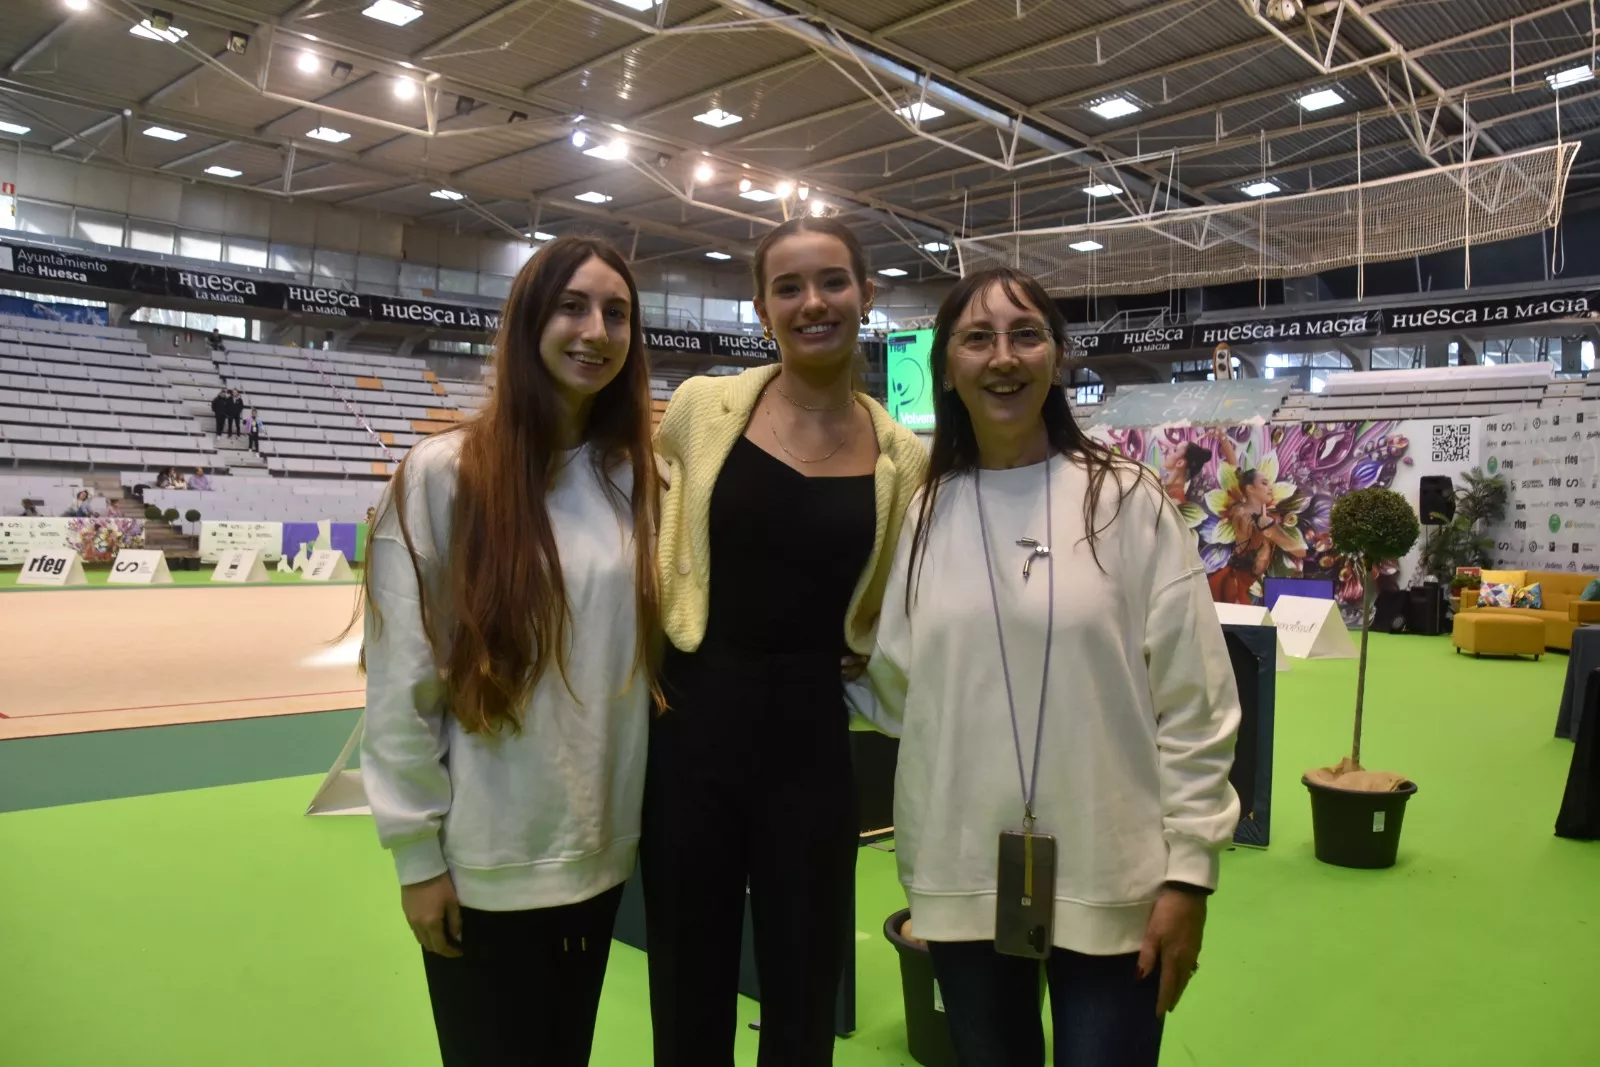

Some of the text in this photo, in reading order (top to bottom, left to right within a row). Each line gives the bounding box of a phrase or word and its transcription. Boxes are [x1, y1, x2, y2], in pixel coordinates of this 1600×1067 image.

[18, 249, 108, 272] Ayuntamiento
[18, 263, 88, 282] de Huesca
[460, 312, 481, 326] La
[1483, 306, 1508, 321] La
[1279, 322, 1300, 336] La
[28, 555, 67, 575] rfeg
